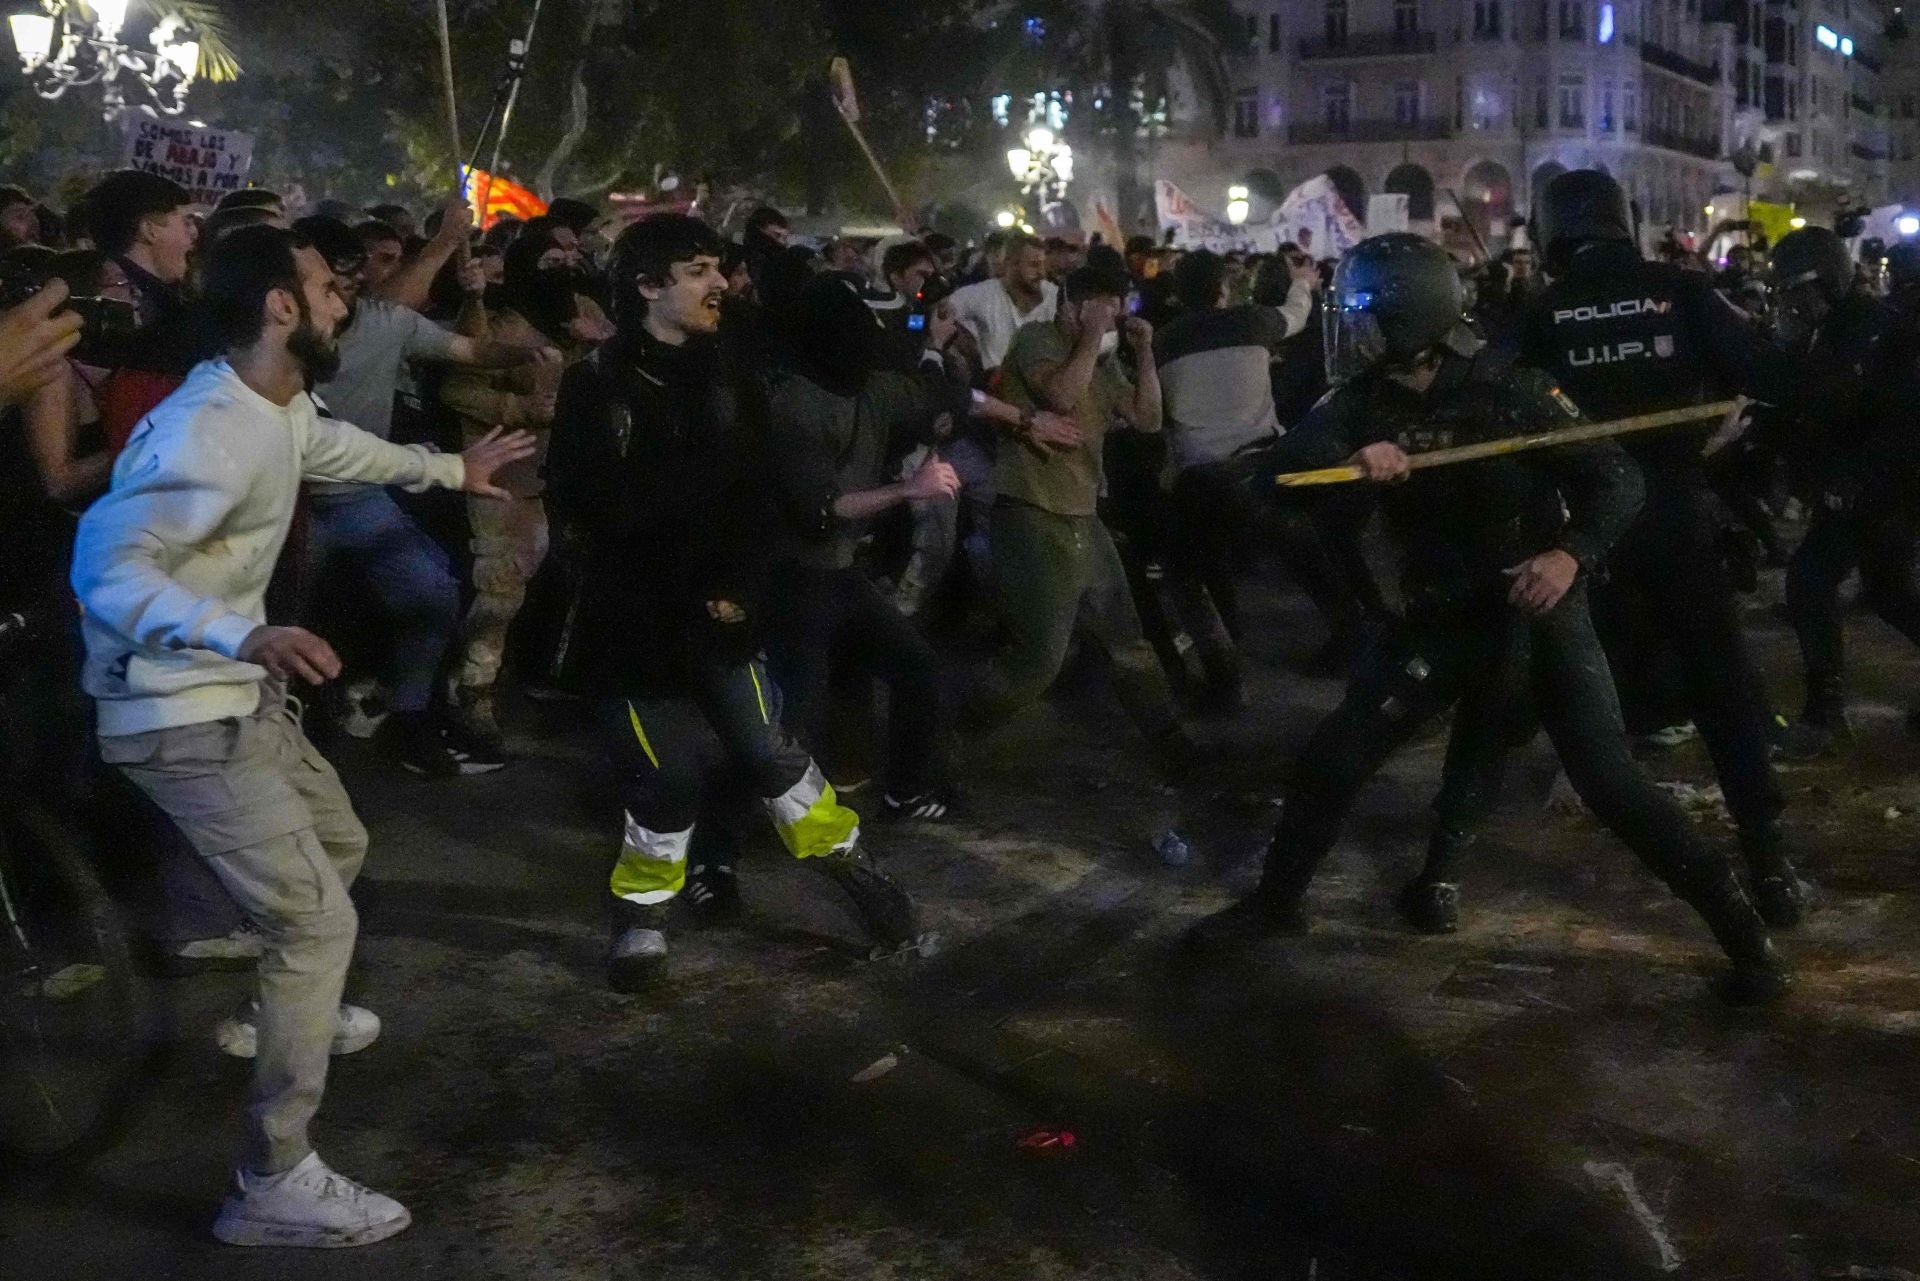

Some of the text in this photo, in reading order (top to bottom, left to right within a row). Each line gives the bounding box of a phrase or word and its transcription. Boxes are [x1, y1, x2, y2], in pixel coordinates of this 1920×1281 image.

[140, 121, 225, 151] SOMOS LOS
[135, 139, 240, 171] DE ABAJO Y
[197, 169, 208, 185] A
[1554, 298, 1659, 324] POLICIA
[1568, 341, 1652, 366] U.I.P.
